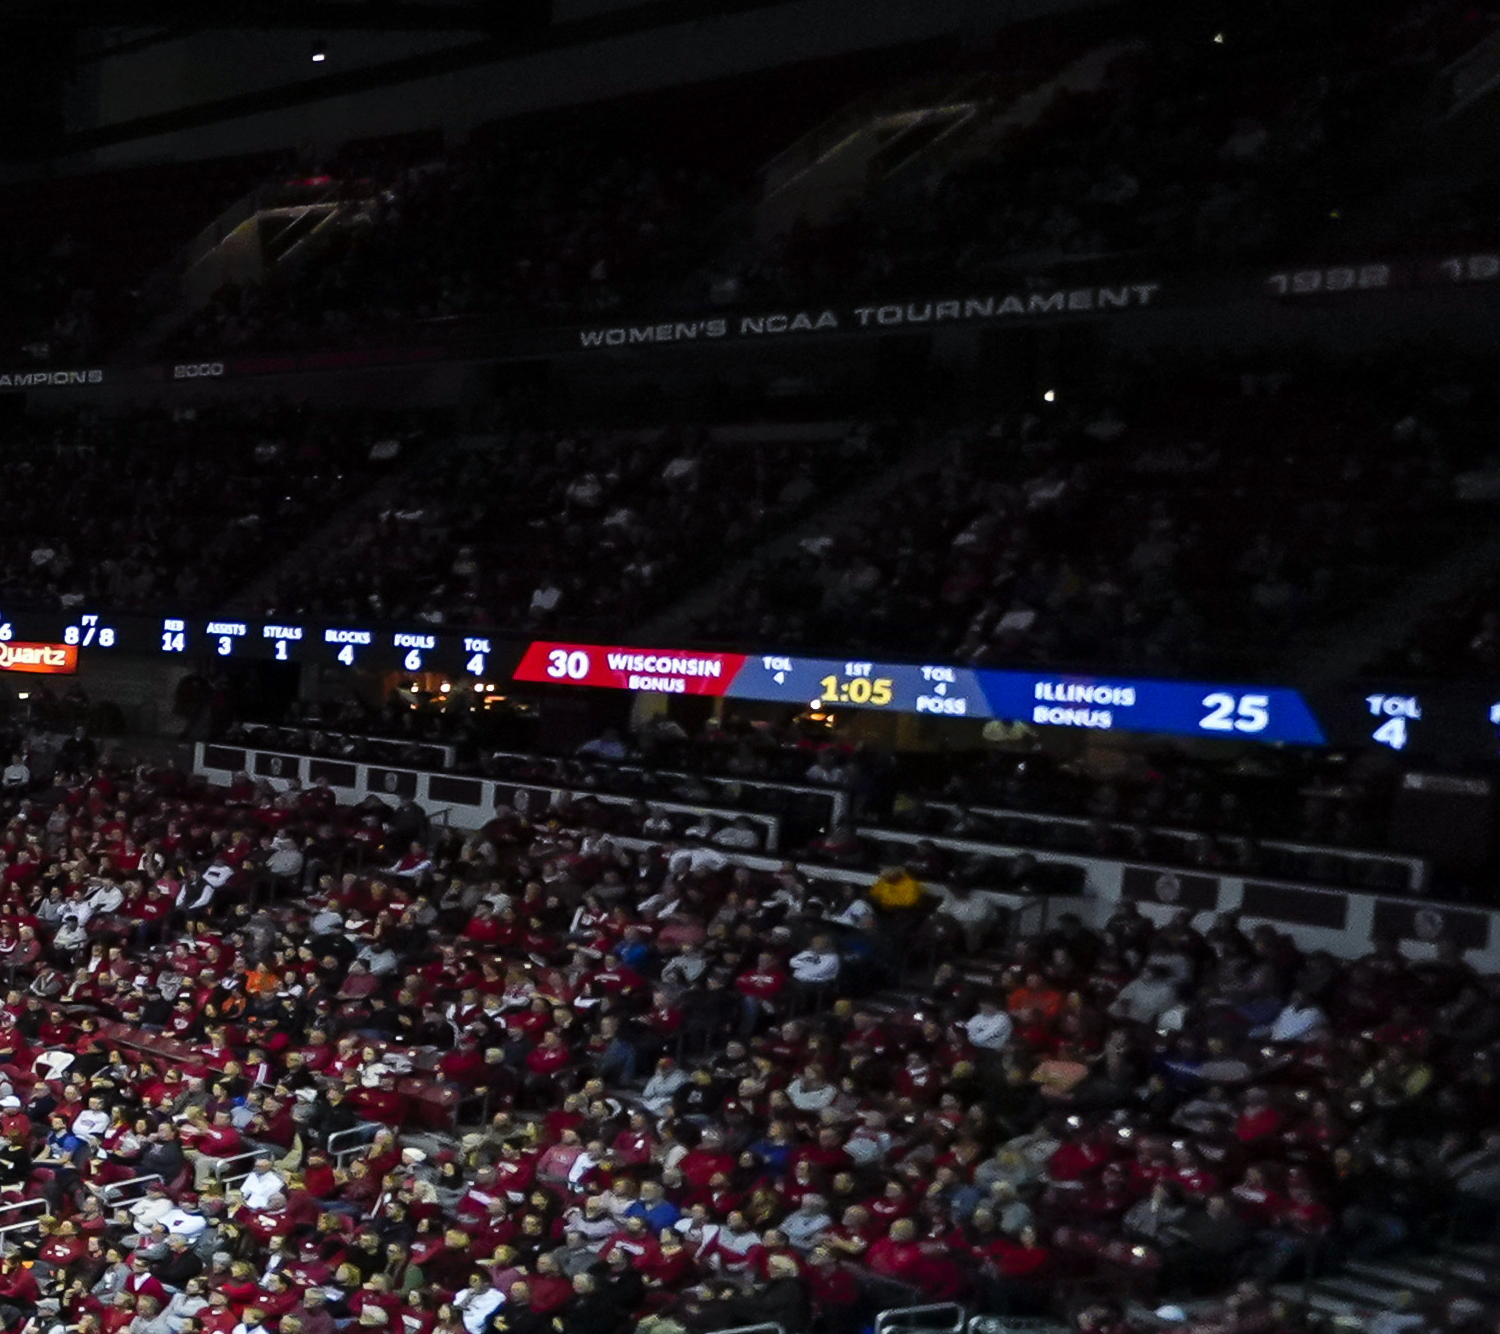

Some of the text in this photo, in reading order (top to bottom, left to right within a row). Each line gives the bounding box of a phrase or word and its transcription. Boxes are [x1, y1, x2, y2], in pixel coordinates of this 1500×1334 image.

[578, 284, 1161, 348] WOMEN'S NCAA TOURNAMENT
[206, 622, 246, 636] ASSISTS
[263, 625, 302, 639] STEALS
[324, 629, 371, 644] BLOCKS
[162, 632, 184, 652] 14
[218, 636, 231, 655] 3
[275, 640, 287, 660] 1
[394, 634, 435, 648] FOULS
[464, 638, 491, 653] TOL
[338, 645, 354, 665] 4
[405, 649, 421, 670] 6
[466, 654, 484, 675] 4
[547, 649, 590, 679] 30
[607, 653, 722, 677] WISCONSIN
[762, 656, 792, 671] TOL
[773, 672, 785, 685] 4
[845, 662, 872, 677] 1ST
[923, 666, 956, 683] TOL
[629, 674, 685, 693] BONUS
[820, 676, 892, 705] 1:05
[934, 683, 947, 696] 4
[1034, 681, 1136, 706] ILLINOIS
[917, 696, 967, 716] POSS
[1199, 693, 1270, 732] 25
[1365, 693, 1421, 720] TOL
[1033, 705, 1113, 729] BONUS
[1373, 717, 1408, 750] 4
